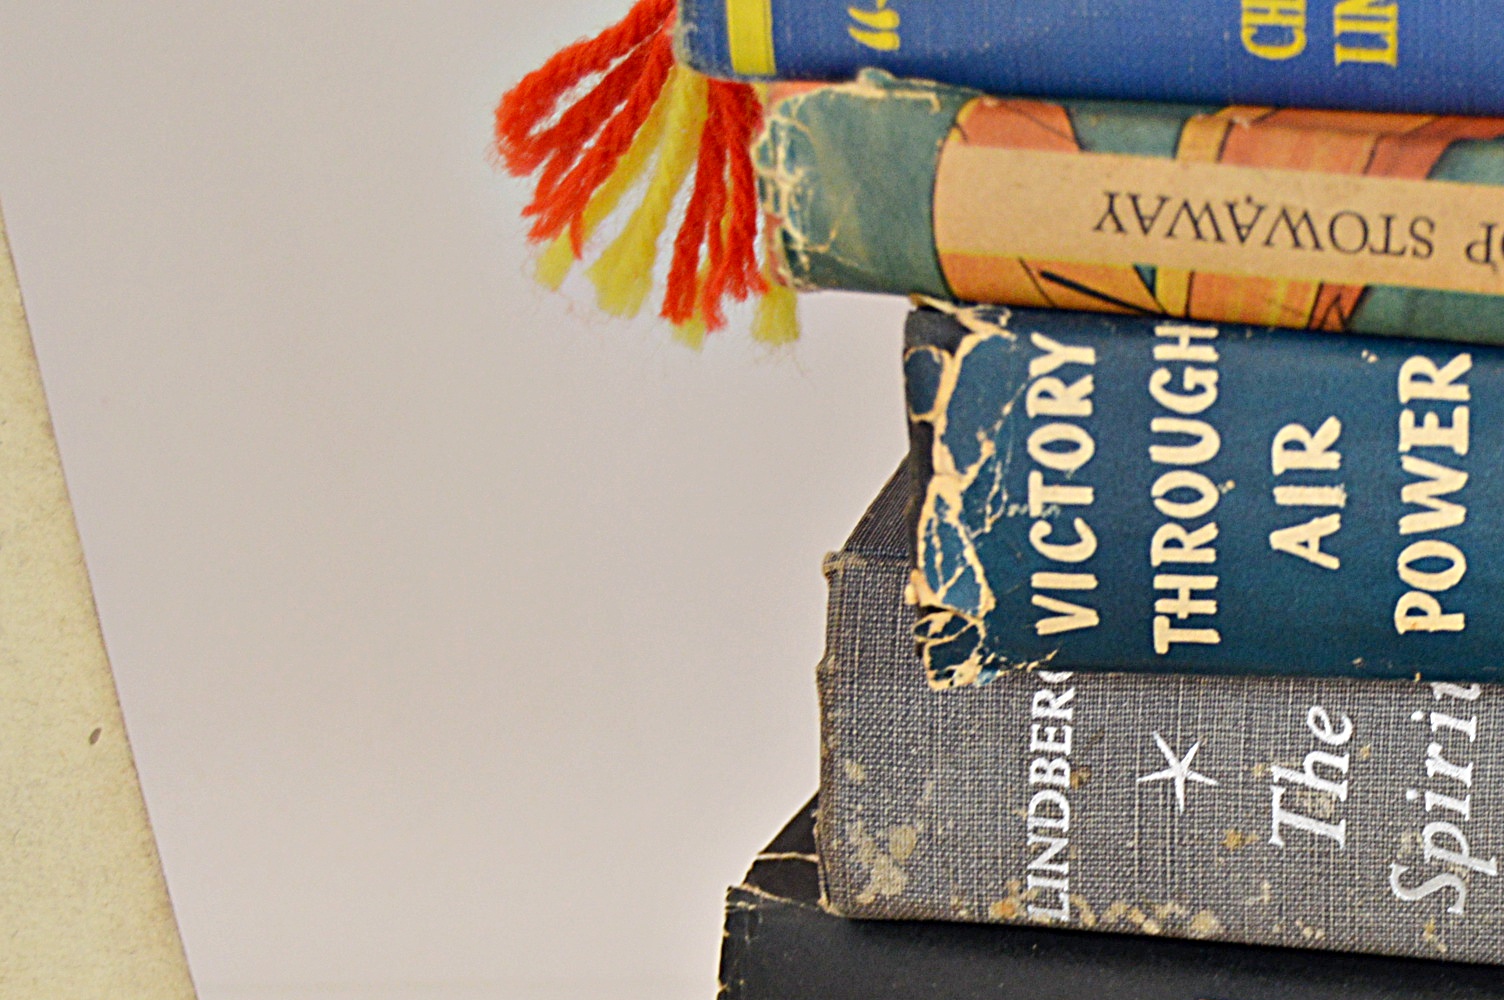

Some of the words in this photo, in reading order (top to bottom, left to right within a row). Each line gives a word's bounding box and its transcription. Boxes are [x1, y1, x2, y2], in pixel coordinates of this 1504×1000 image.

[1094, 190, 1436, 258] STOWAWAY
[1026, 332, 1100, 636] VICTORY
[1148, 325, 1221, 655] THROUGH
[1269, 416, 1345, 569] AIR
[1394, 353, 1473, 634] POWER
[1268, 704, 1354, 849] The
